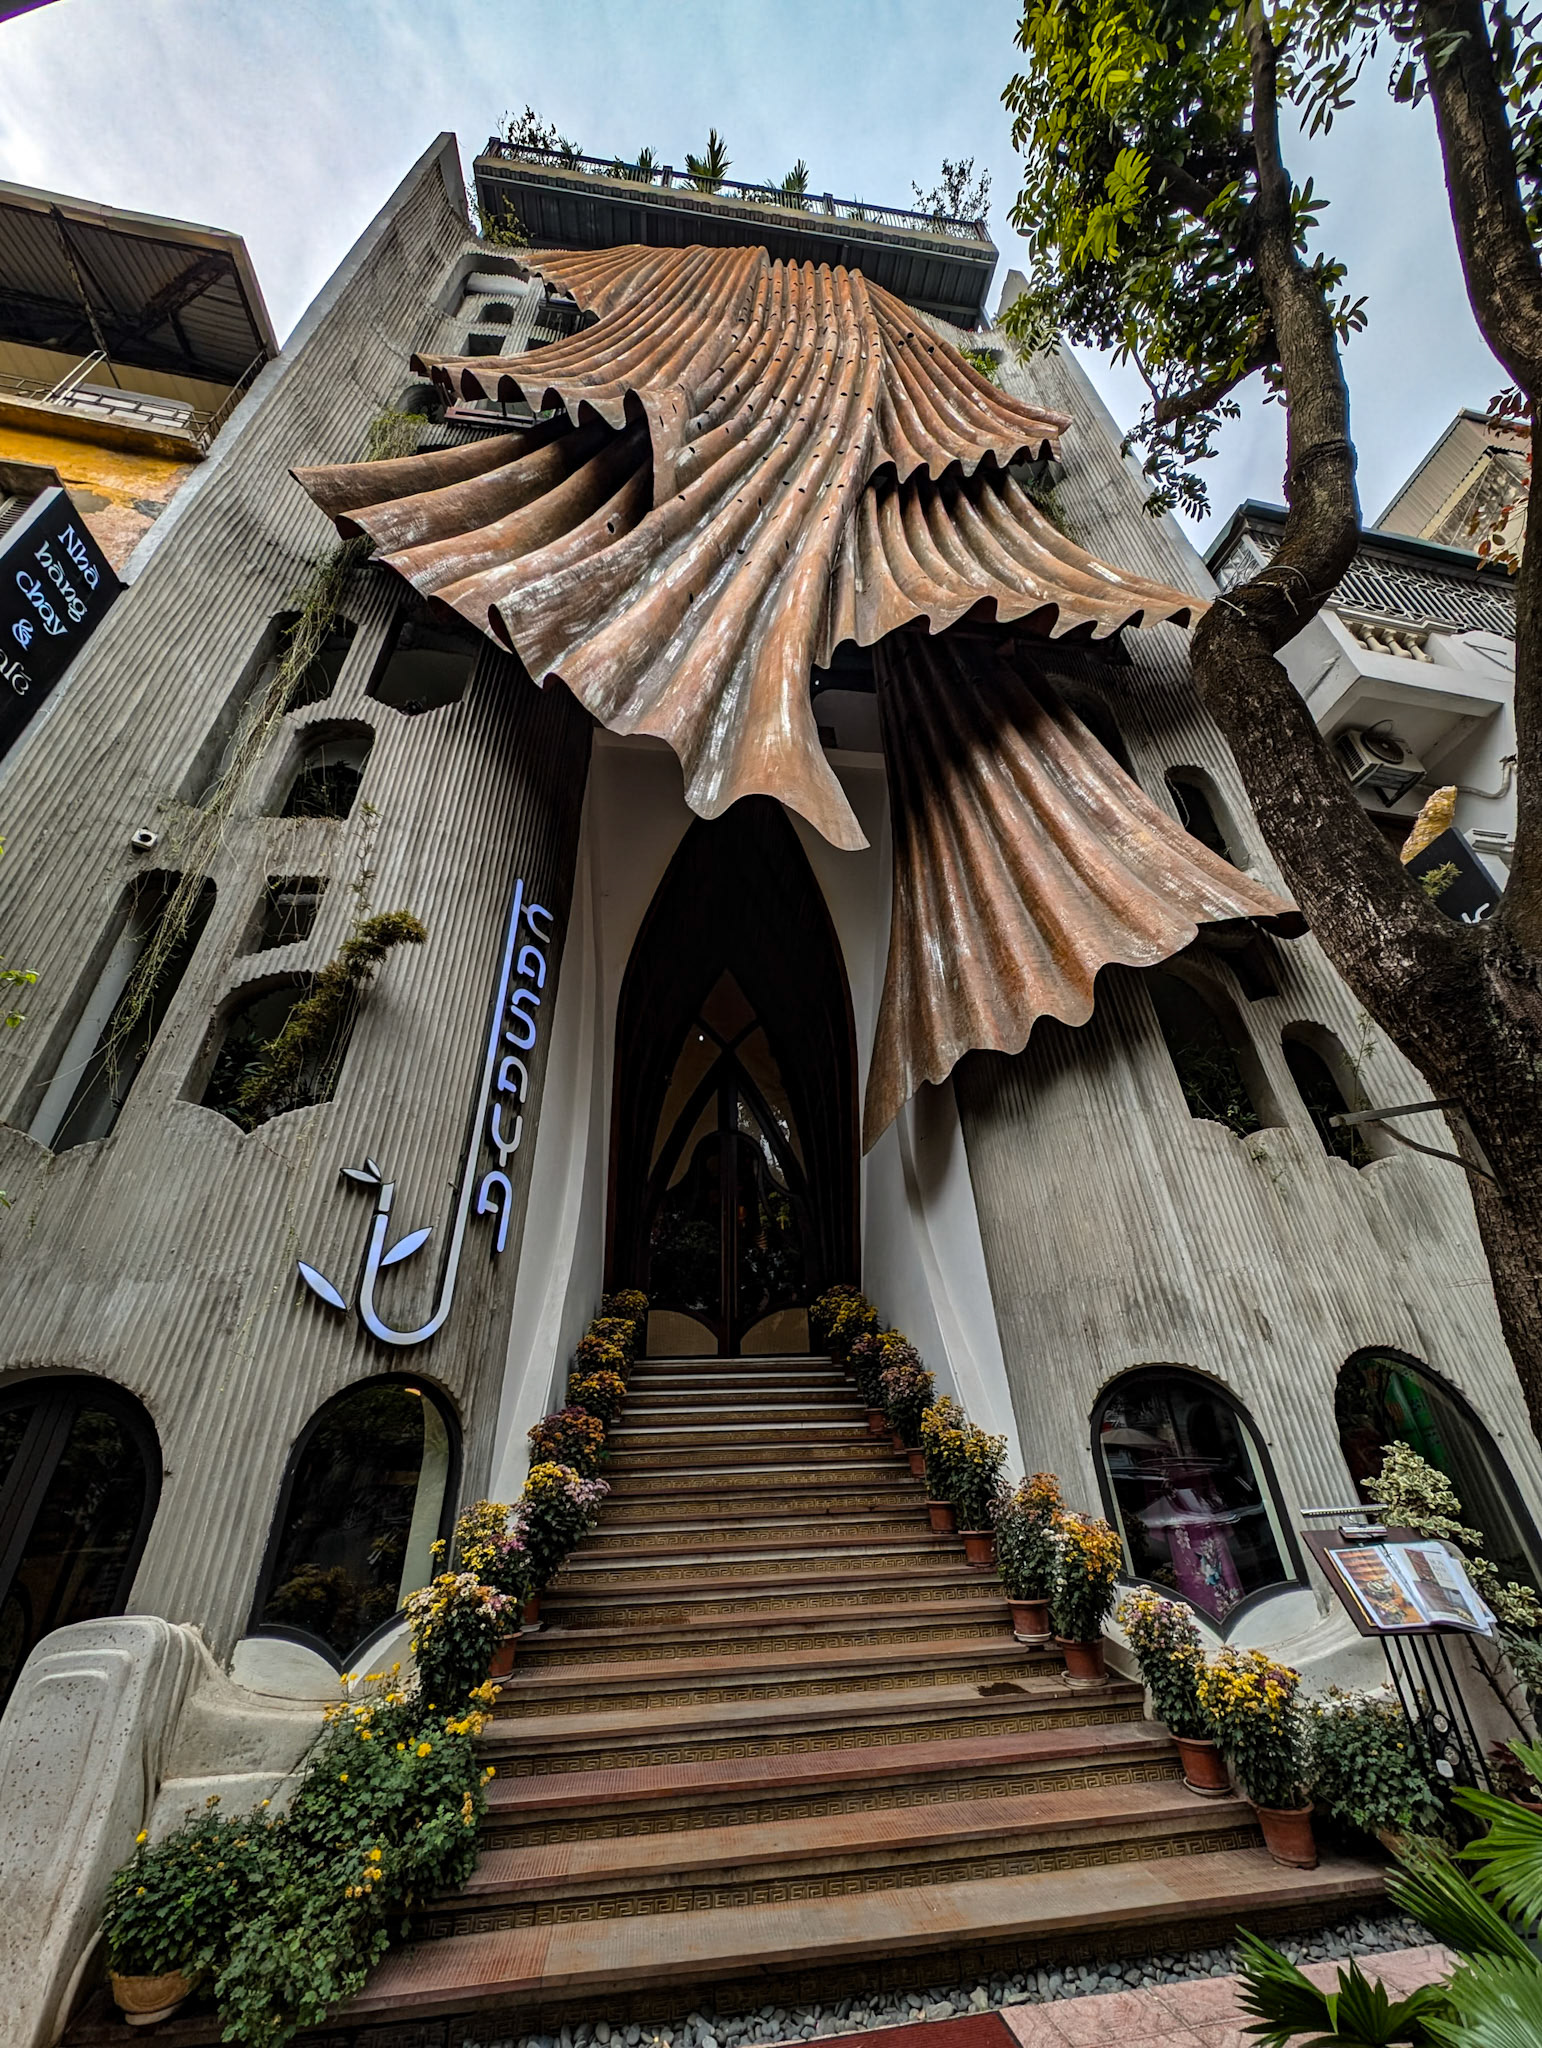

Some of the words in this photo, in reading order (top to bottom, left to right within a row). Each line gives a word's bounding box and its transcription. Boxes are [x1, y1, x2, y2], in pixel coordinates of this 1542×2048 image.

[34, 540, 88, 623] hàng
[57, 523, 100, 591] Nhà
[11, 618, 34, 651] &
